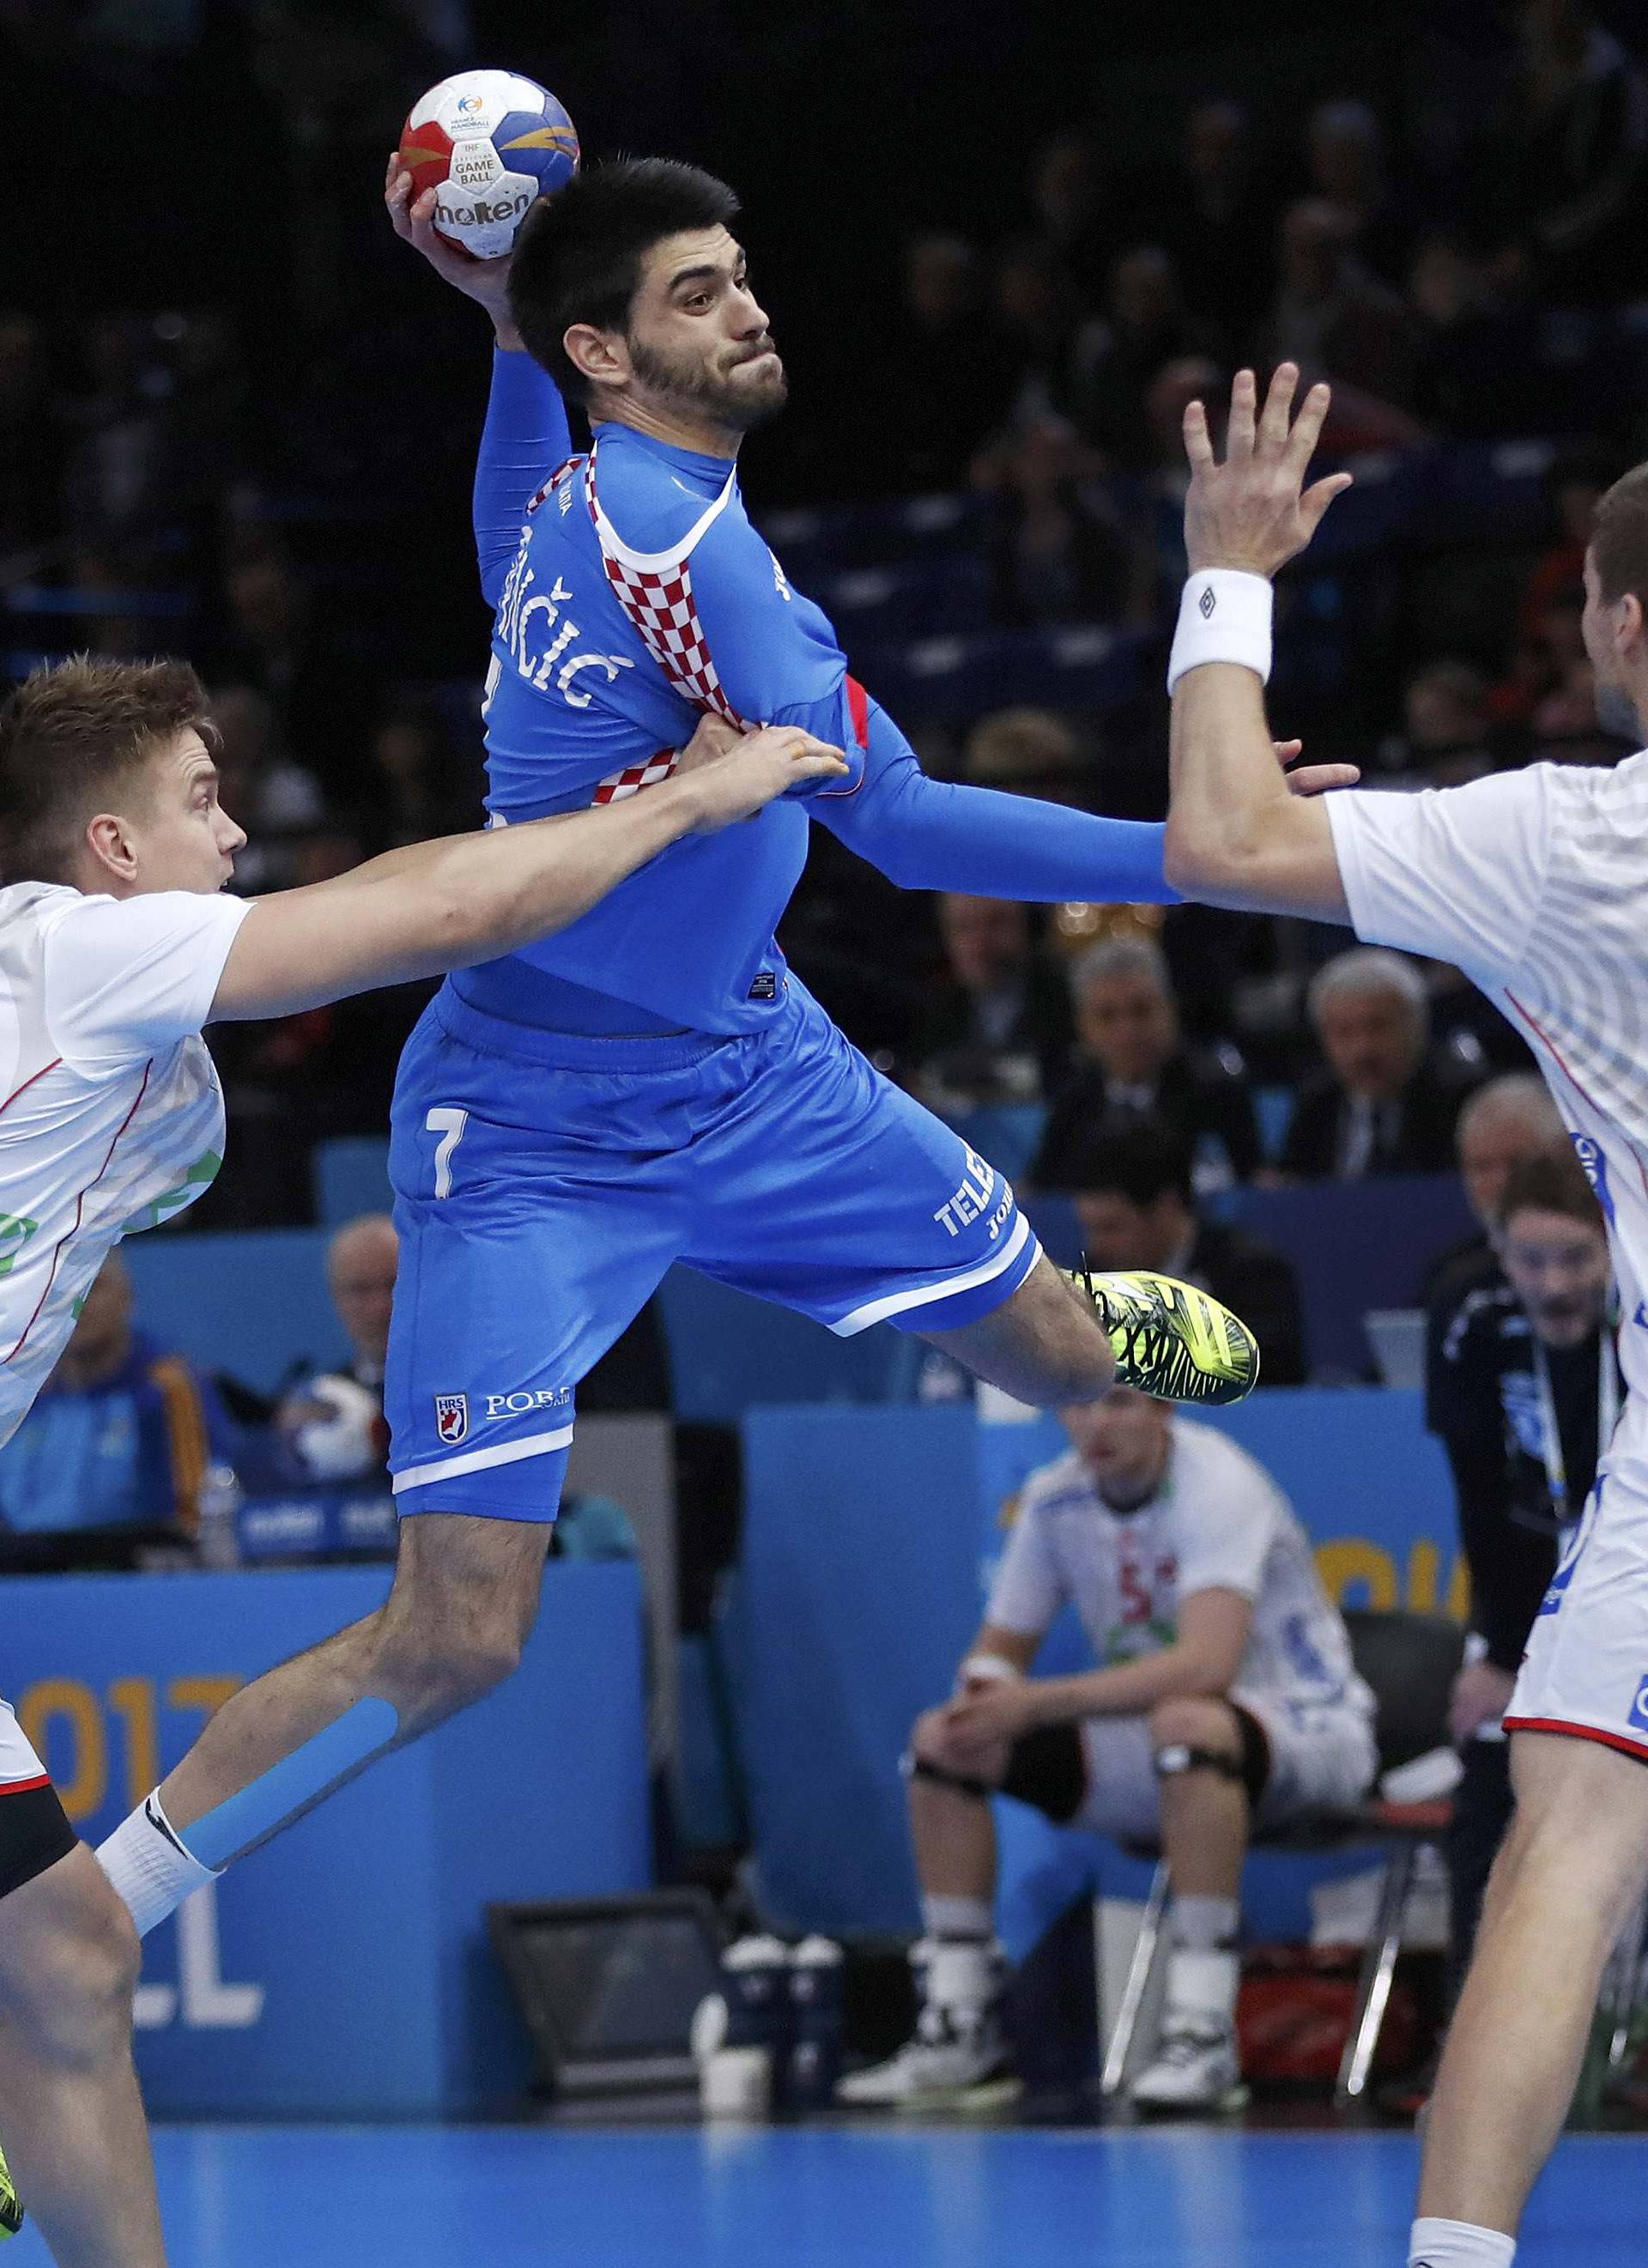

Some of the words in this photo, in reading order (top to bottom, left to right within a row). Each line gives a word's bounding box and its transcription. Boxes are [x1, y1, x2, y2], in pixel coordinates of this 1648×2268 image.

[456, 159, 495, 174] GAME
[461, 171, 494, 185] BALL
[425, 1107, 470, 1200] 7
[439, 1397, 464, 1410] HRS
